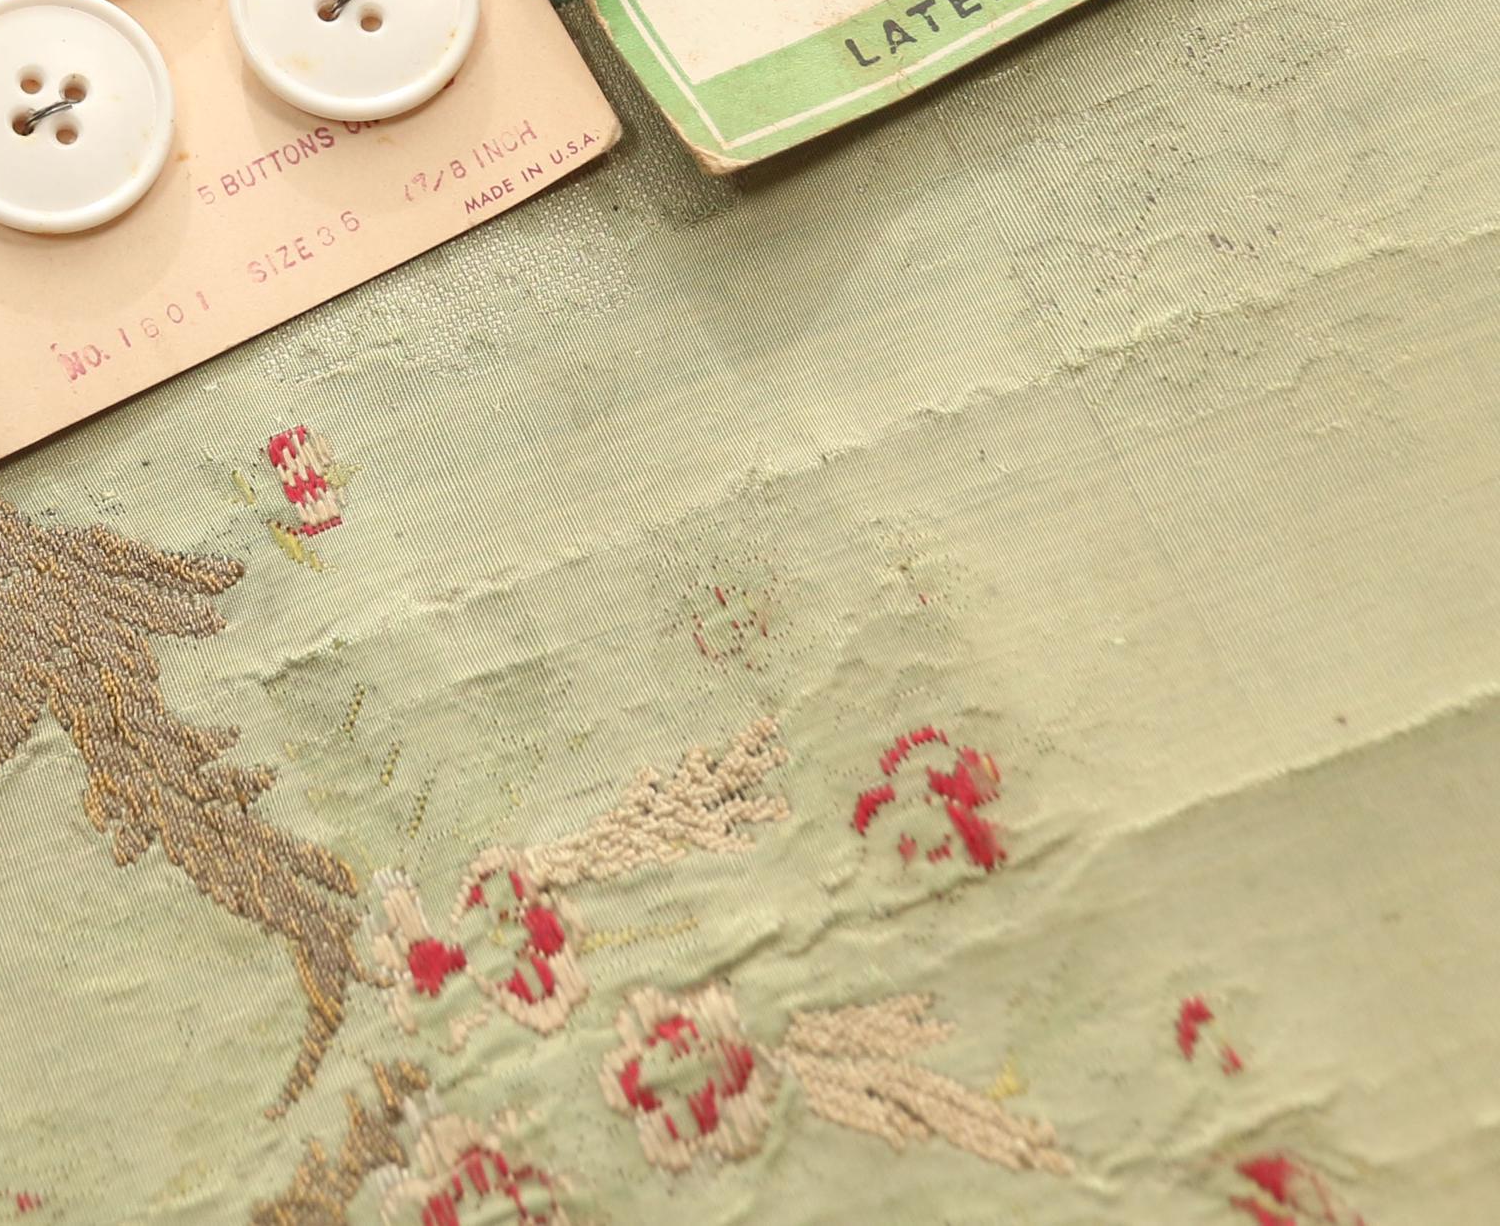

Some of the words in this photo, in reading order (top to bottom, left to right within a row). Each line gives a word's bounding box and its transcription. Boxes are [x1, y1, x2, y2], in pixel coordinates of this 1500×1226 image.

[197, 185, 216, 205] 5
[220, 127, 335, 196] BUTTONS
[464, 178, 515, 214] MADE
[521, 163, 544, 182] IN
[550, 133, 600, 165] U.S.A.
[473, 120, 537, 168] INCH
